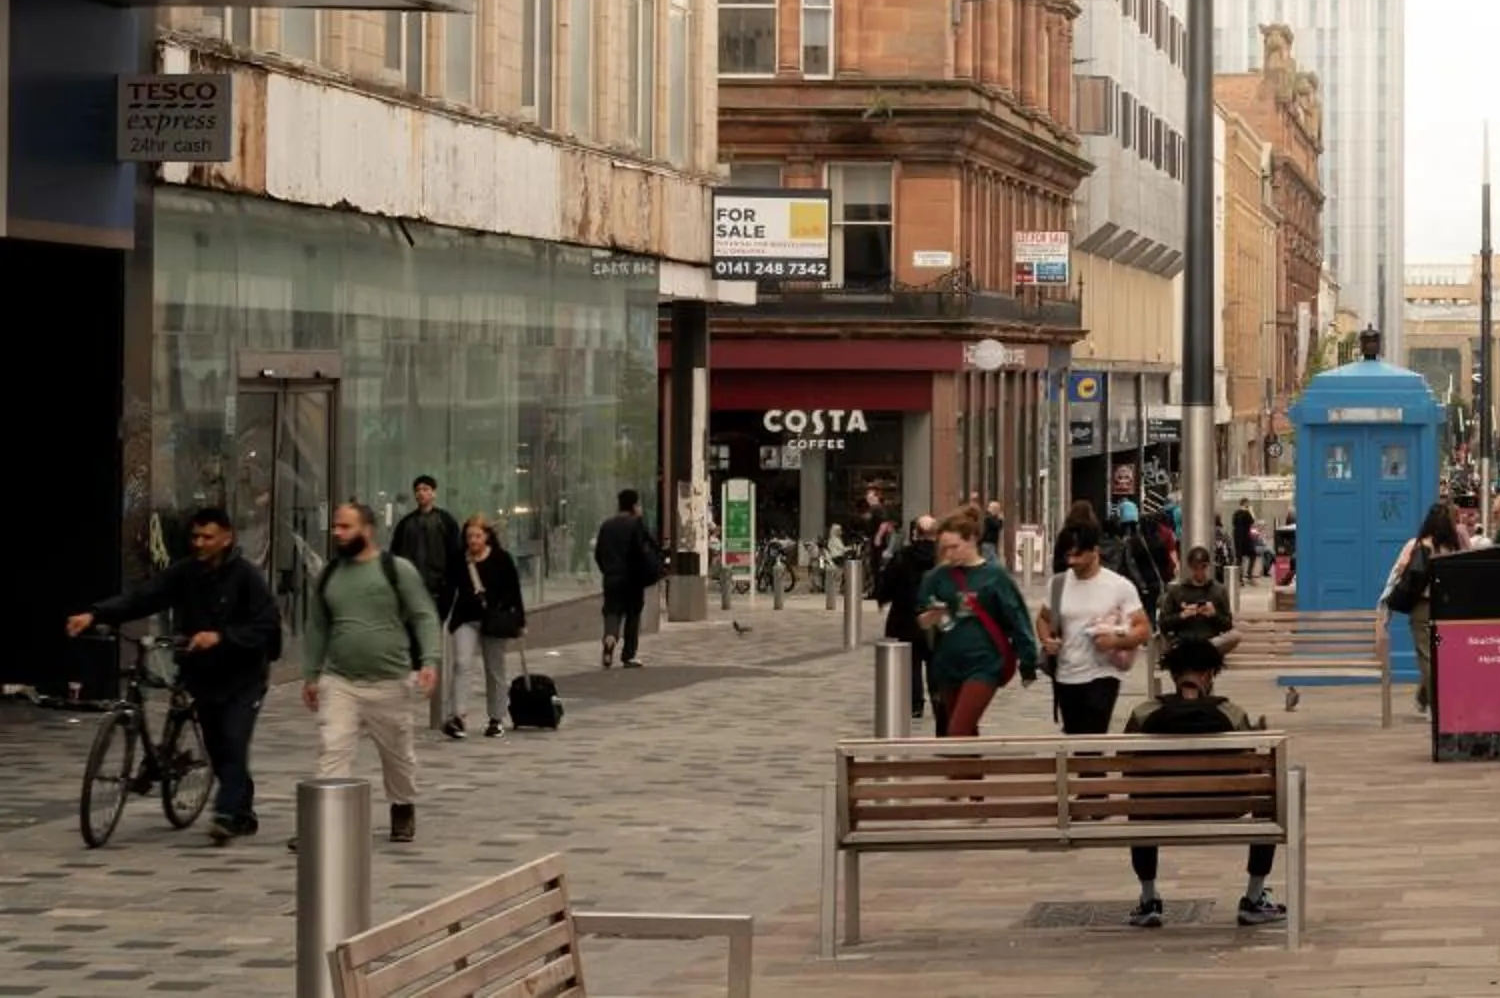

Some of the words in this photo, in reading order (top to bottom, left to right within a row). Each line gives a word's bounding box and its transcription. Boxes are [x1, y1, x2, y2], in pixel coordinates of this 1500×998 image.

[127, 83, 216, 101] TESCO
[127, 114, 217, 135] express
[130, 136, 166, 153] 24hr
[174, 137, 212, 153] cash
[716, 208, 756, 222] FOR
[716, 225, 765, 239] SALE
[715, 261, 750, 275] 0141
[755, 262, 784, 275] 248
[788, 263, 827, 276] 7342
[763, 409, 869, 435] COSTA
[787, 439, 845, 449] COFFEE
